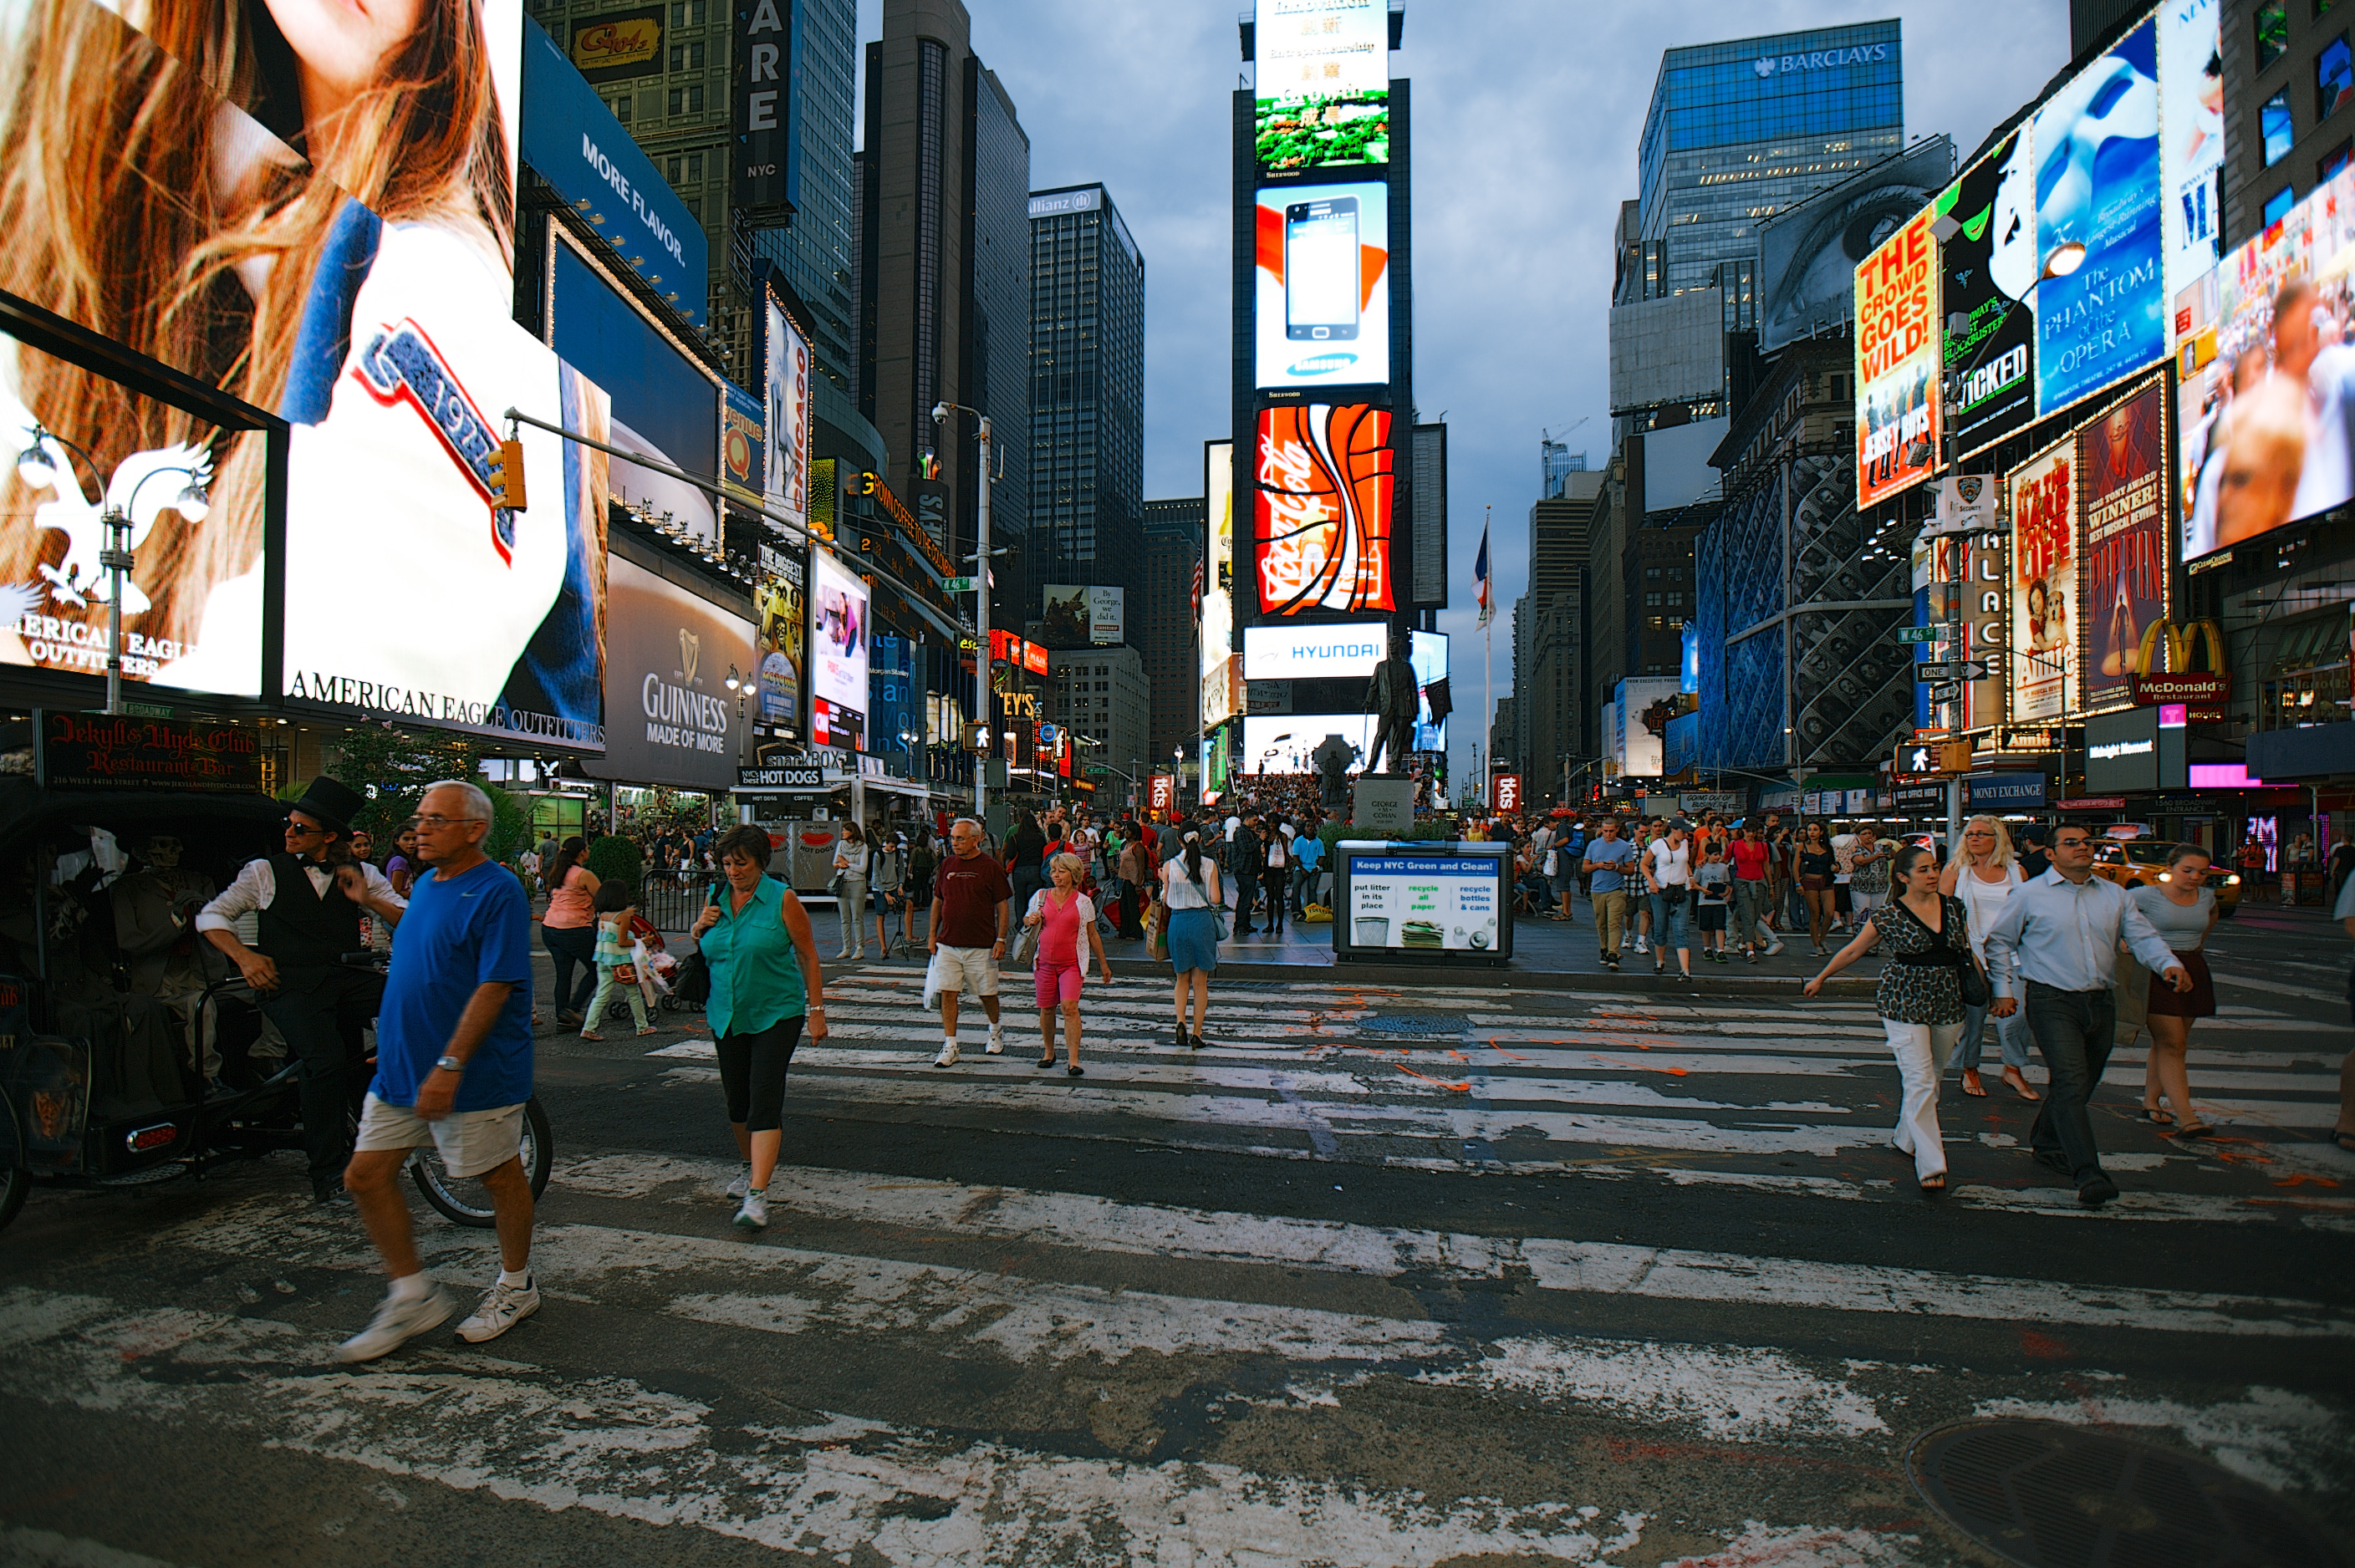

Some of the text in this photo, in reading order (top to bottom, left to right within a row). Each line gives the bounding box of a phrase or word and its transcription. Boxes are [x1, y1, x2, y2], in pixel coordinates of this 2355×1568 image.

[1781, 44, 1886, 73] BARCLAYS
[1280, 84, 1364, 104] Growth
[1300, 105, 1341, 127] 成長
[748, 164, 776, 178] NYC
[583, 133, 686, 268] MORE FLAVOR.
[2098, 186, 2144, 223] Broadway's
[2085, 194, 2157, 247] Longest-Running
[2103, 220, 2137, 250] Musical
[1861, 259, 1928, 324] CROWD
[2082, 267, 2108, 291] The
[2045, 257, 2154, 341] PHANTOM
[1861, 284, 1928, 354] GOES
[2078, 309, 2116, 340] of the
[2060, 321, 2131, 373] OPERA
[1295, 358, 1351, 371] SAMSUNG
[435, 379, 489, 463] 1977
[794, 347, 805, 513] CHICAGO
[1863, 419, 1899, 465] JERSEY
[1900, 402, 1929, 444] BOYS
[726, 426, 751, 482] Q
[2043, 461, 2069, 495] THE
[2088, 471, 2158, 512] 2013 TONY AWARD
[894, 498, 915, 538] COFFEE
[1261, 432, 1312, 588] Coca-Cola
[2017, 485, 2070, 536] HARD
[2088, 482, 2158, 530] WINNER!
[2017, 509, 2070, 557] KNOCK
[2089, 502, 2158, 544] BEST MUSICAL REVIVAL
[760, 544, 803, 578] THE BIGGEST
[2017, 532, 2070, 587] LIFE
[944, 580, 950, 590] W
[951, 579, 961, 590] 46
[1104, 590, 1112, 598] By
[2088, 531, 2162, 625] PIPPIN
[1093, 597, 1120, 606] George,
[1293, 644, 1379, 659] HYUNDAI
[1900, 632, 1909, 642] W
[1911, 629, 1924, 641] 46
[1924, 668, 1944, 677] ONE
[2016, 638, 2076, 690] Annie
[643, 673, 727, 733] GUINNESS
[1937, 690, 1949, 700] ONE
[2139, 682, 2227, 693] McDonald's
[129, 705, 171, 717] BROADWAY
[292, 670, 604, 744] AMERICAN EAGLE OUTFITTERS
[208, 728, 255, 753] Club
[647, 722, 724, 754] MADE OF MORE
[2008, 733, 2051, 748] Annie
[87, 751, 233, 777] Restaurant Bar
[760, 771, 818, 784] HOT DOGS
[1154, 778, 1169, 808] tkts
[1500, 777, 1517, 809] tkts
[1897, 787, 1937, 799] BOX OFFICE HERE
[1973, 784, 2042, 799] MONEY EXCHANGE
[800, 845, 834, 854] HOT DOGS
[1357, 862, 1381, 871] Keep
[1407, 862, 1437, 870] Green
[1461, 863, 1493, 871] Clean!
